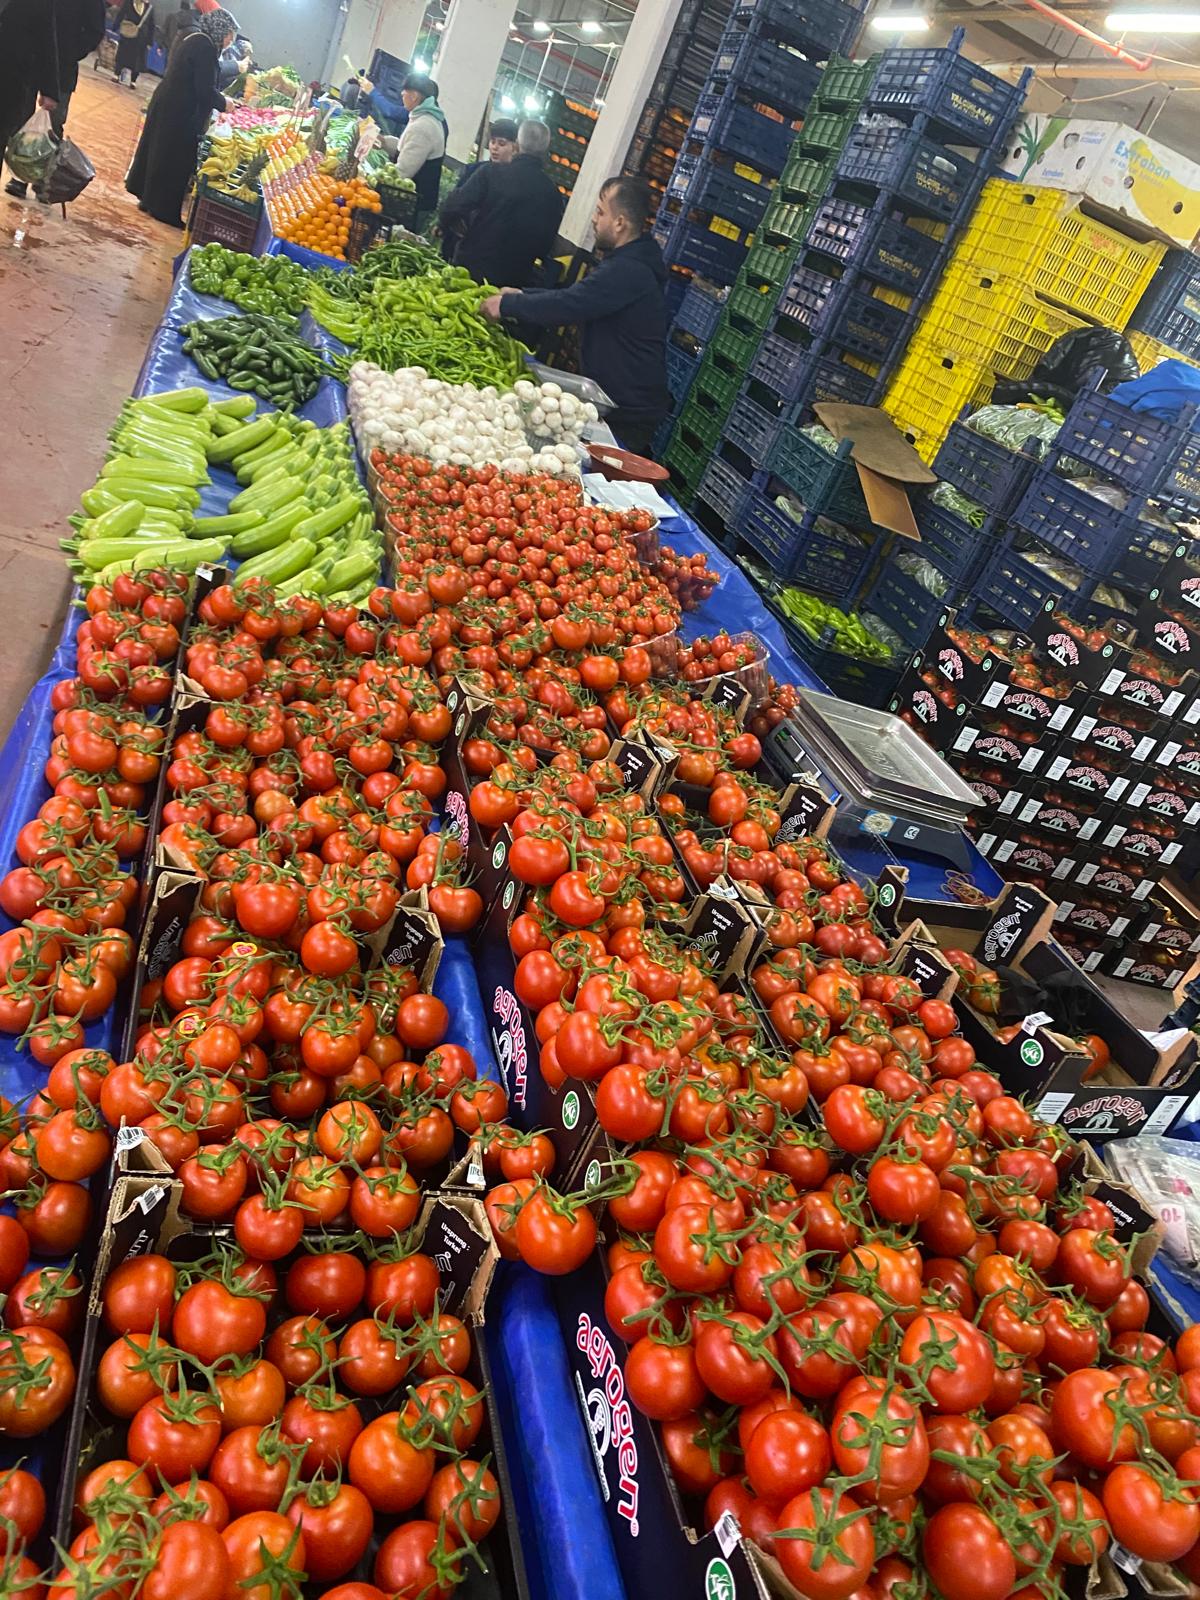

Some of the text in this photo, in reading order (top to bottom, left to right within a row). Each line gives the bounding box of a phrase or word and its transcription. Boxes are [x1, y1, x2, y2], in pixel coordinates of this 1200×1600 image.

[1003, 693, 1051, 717] agrogen
[1120, 680, 1164, 703] agrogen
[985, 912, 1020, 961] agrogen
[493, 985, 527, 1107] agrogen
[1063, 1095, 1147, 1126] agrogen
[441, 1222, 467, 1249] Ursprung
[577, 1312, 639, 1530] agrogen
